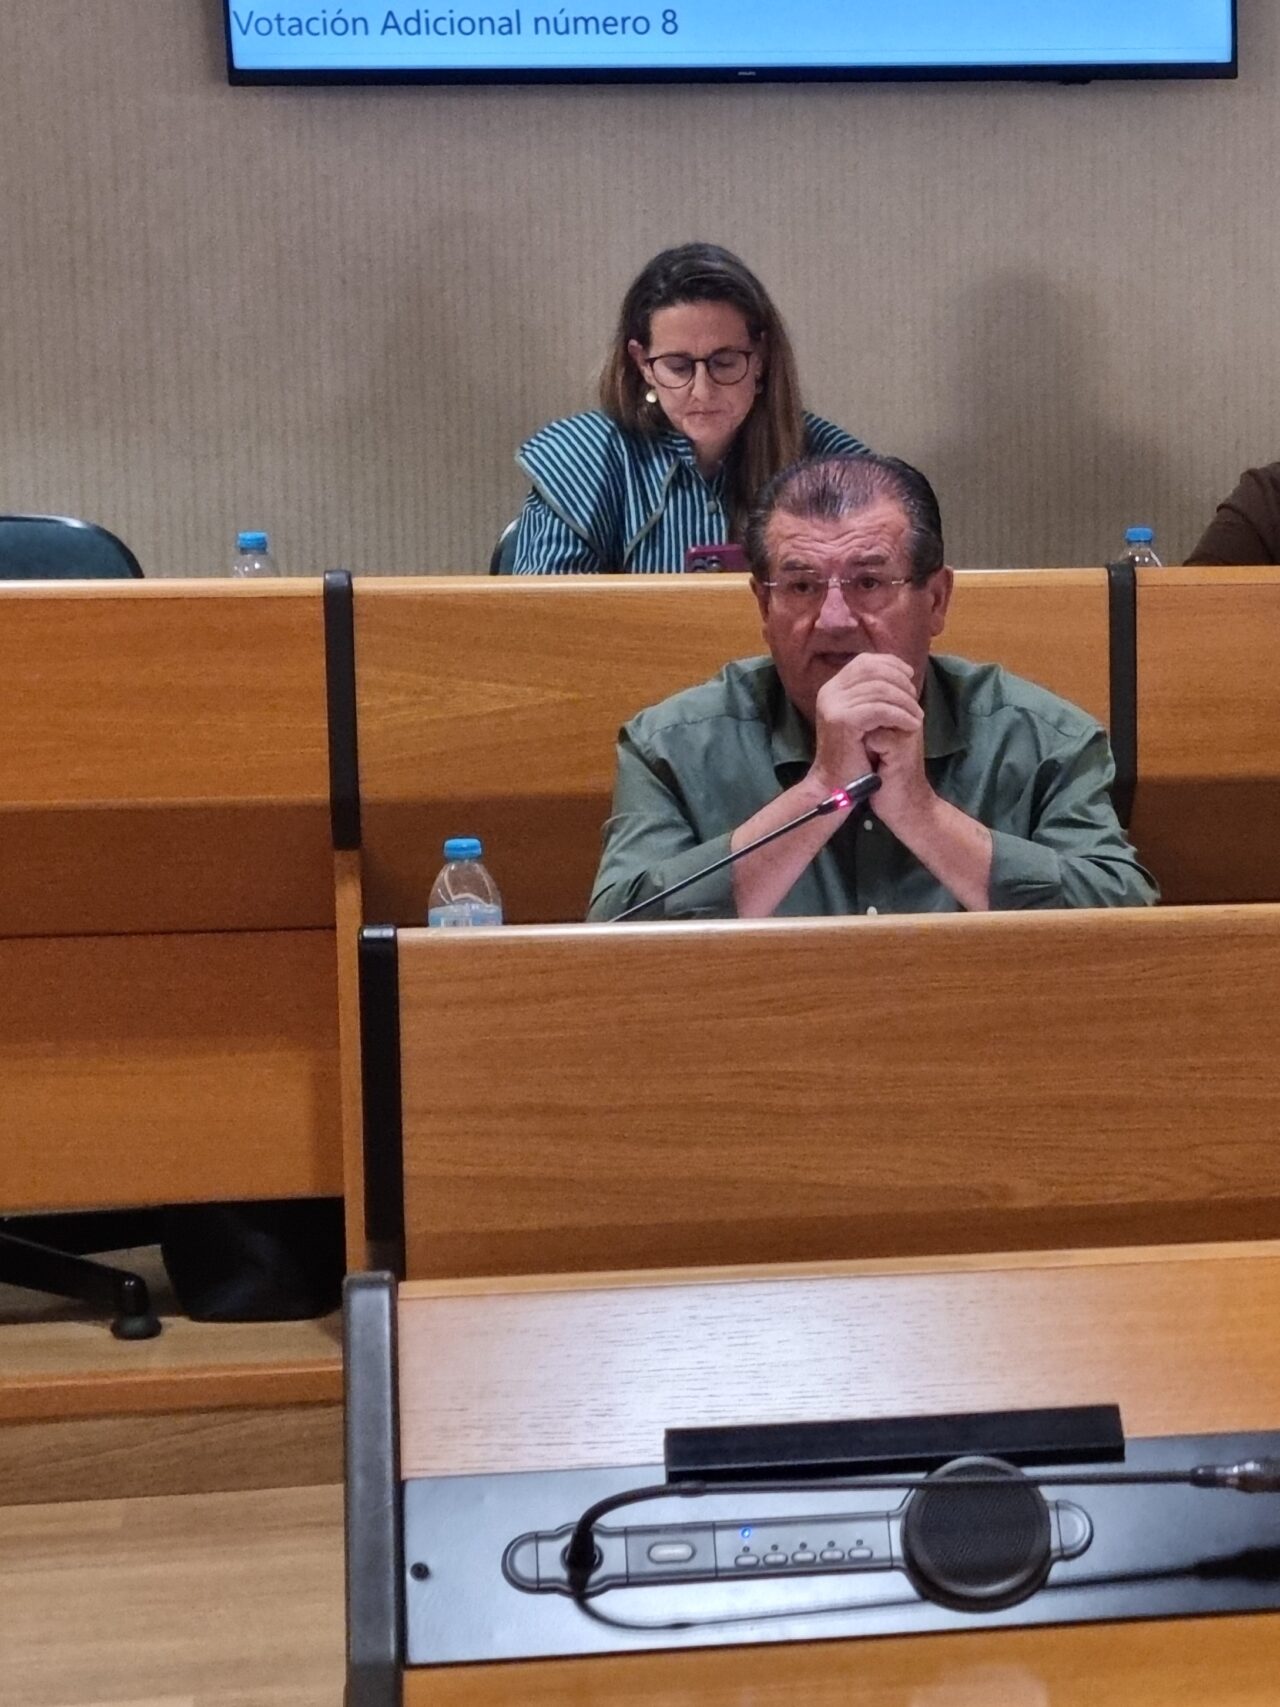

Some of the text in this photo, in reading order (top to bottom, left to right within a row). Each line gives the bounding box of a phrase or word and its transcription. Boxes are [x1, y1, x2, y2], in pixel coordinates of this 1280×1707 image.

[232, 8, 679, 36] Votación Adicional número 8
